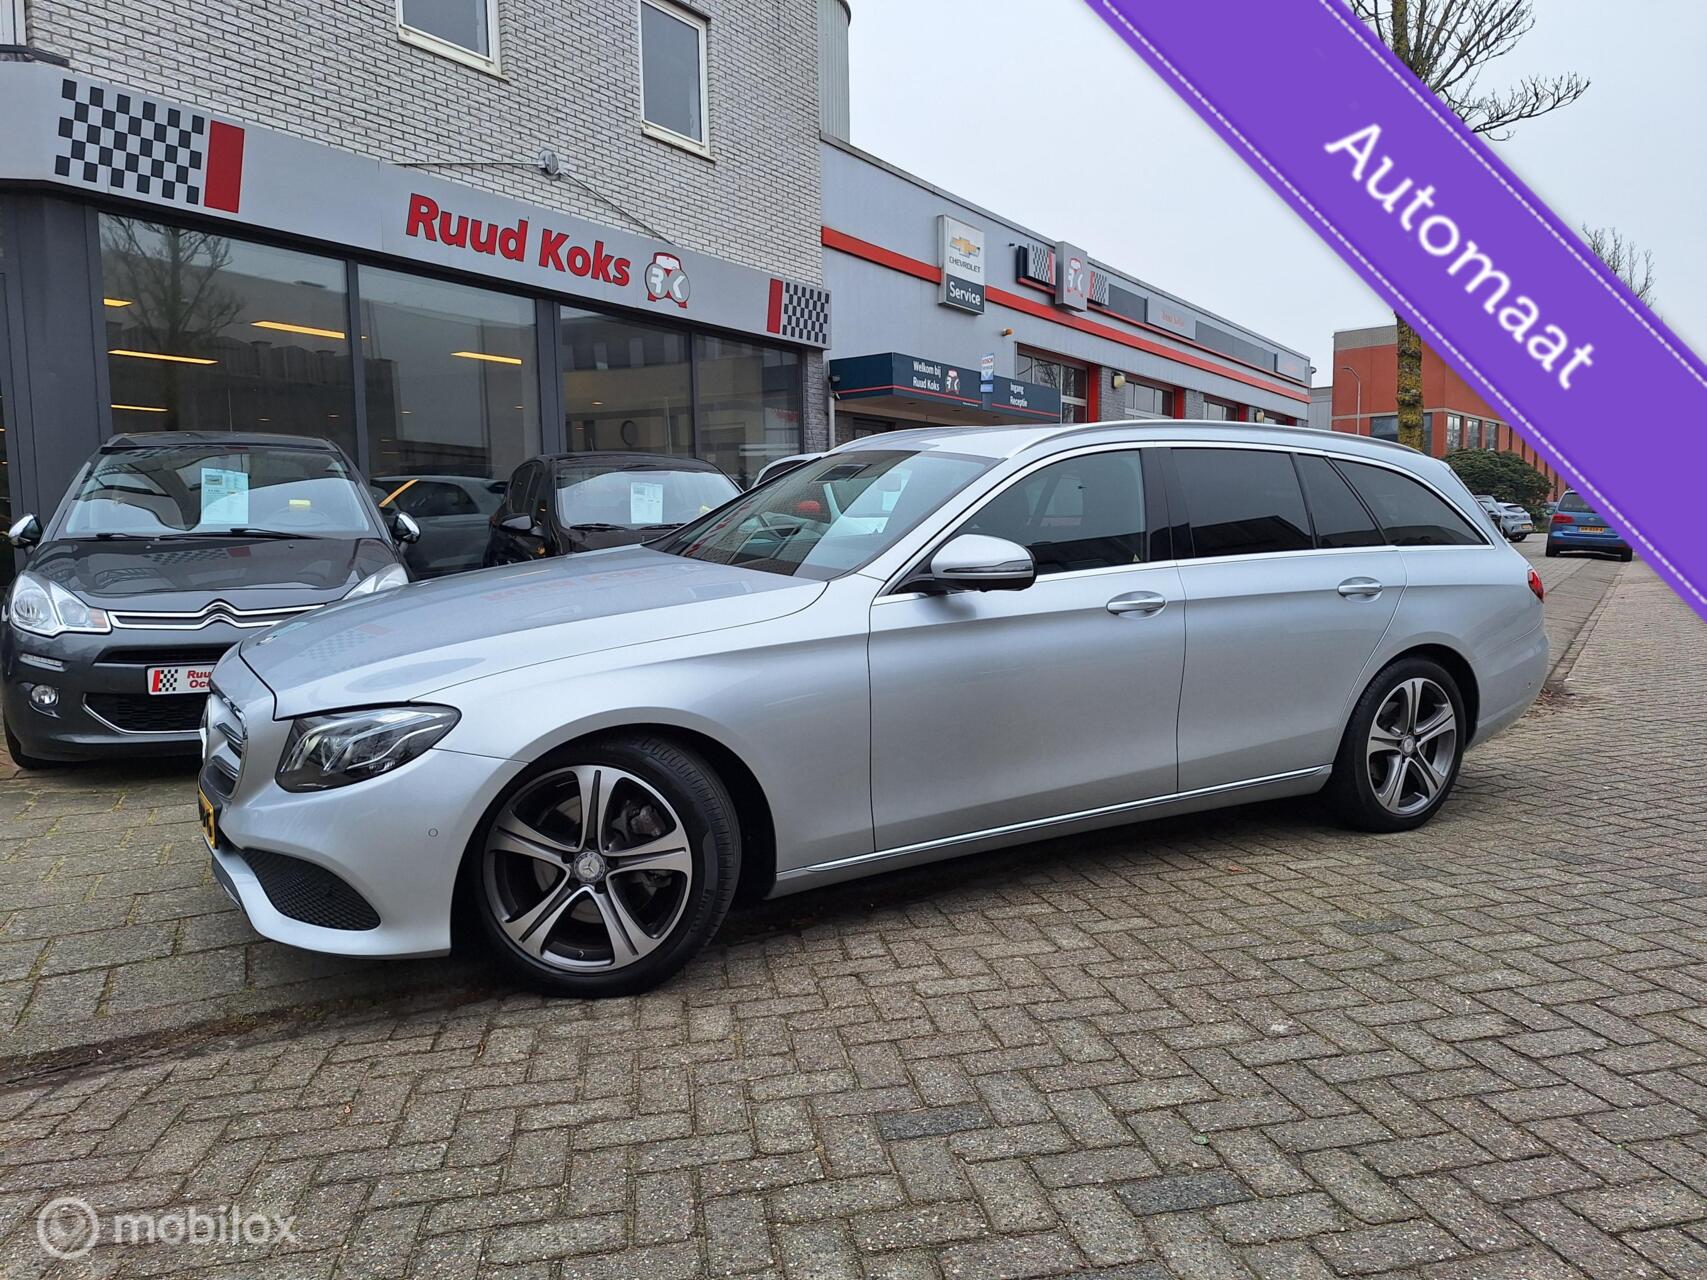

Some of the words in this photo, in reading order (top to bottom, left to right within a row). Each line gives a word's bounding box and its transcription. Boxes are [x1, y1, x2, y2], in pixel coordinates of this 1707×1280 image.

[405, 192, 529, 262] Ruud
[538, 228, 631, 287] Koks
[948, 256, 981, 273] CHEVROLET
[949, 281, 981, 306] Service
[913, 361, 934, 375] Welkom
[934, 365, 942, 378] bij
[913, 376, 927, 389] Ruud
[927, 379, 940, 391] Koks
[187, 670, 212, 679] Ruu
[189, 680, 211, 689] Oc
